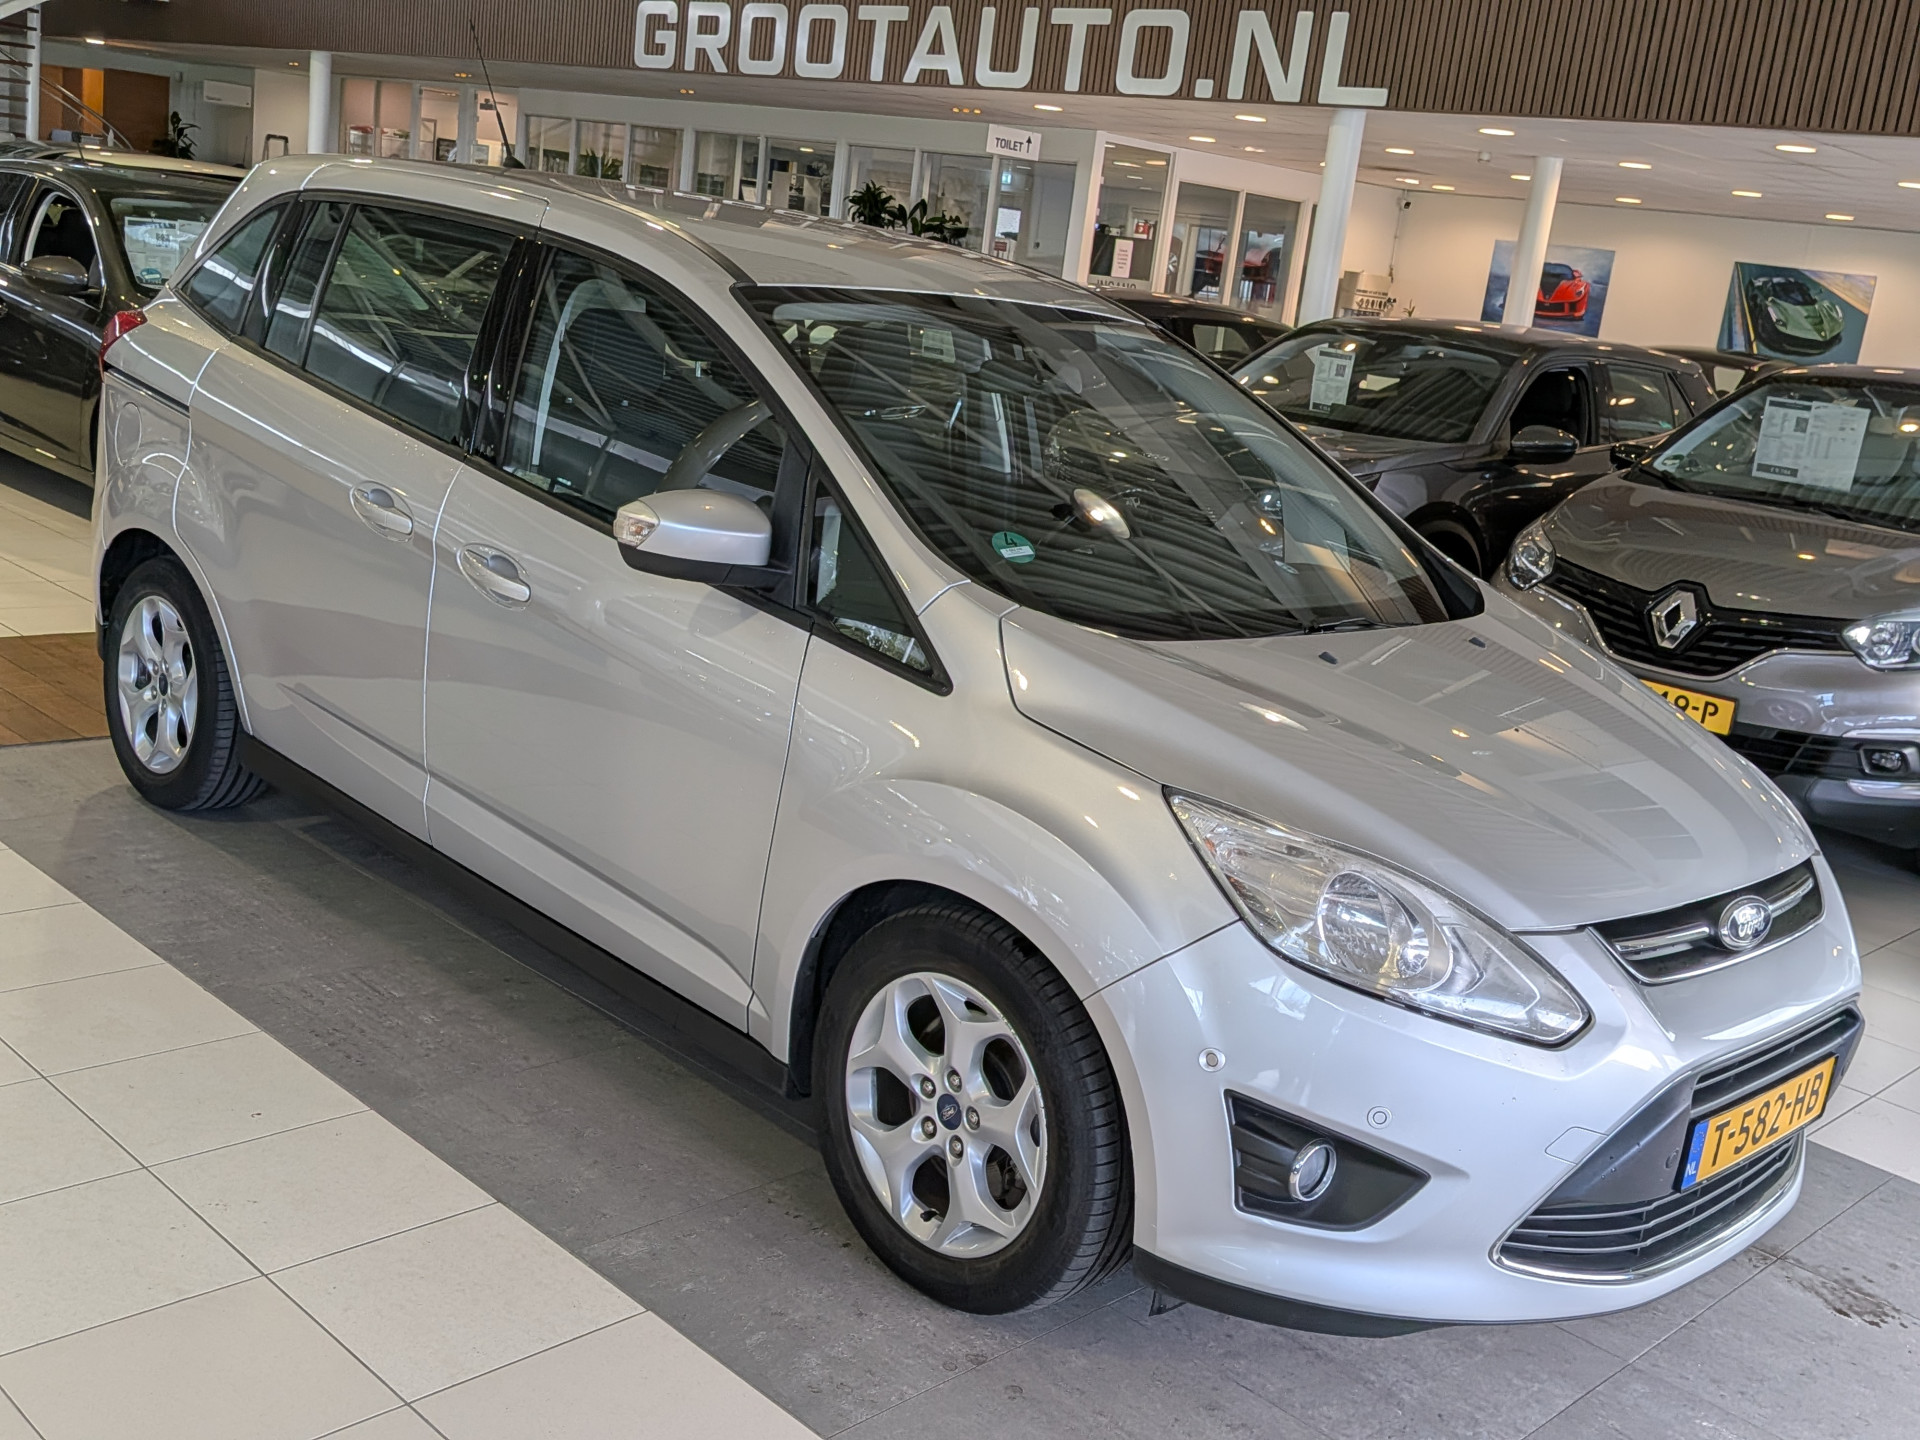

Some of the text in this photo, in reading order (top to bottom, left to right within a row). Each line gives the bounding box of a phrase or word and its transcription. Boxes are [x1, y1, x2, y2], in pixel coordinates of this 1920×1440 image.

[634, 1, 1388, 106] GROOTAUTO.NL
[995, 137, 1024, 152] TOILET
[1736, 906, 1765, 938] Ford
[1712, 1071, 1824, 1167] T-582-HB
[1685, 1161, 1697, 1178] NL
